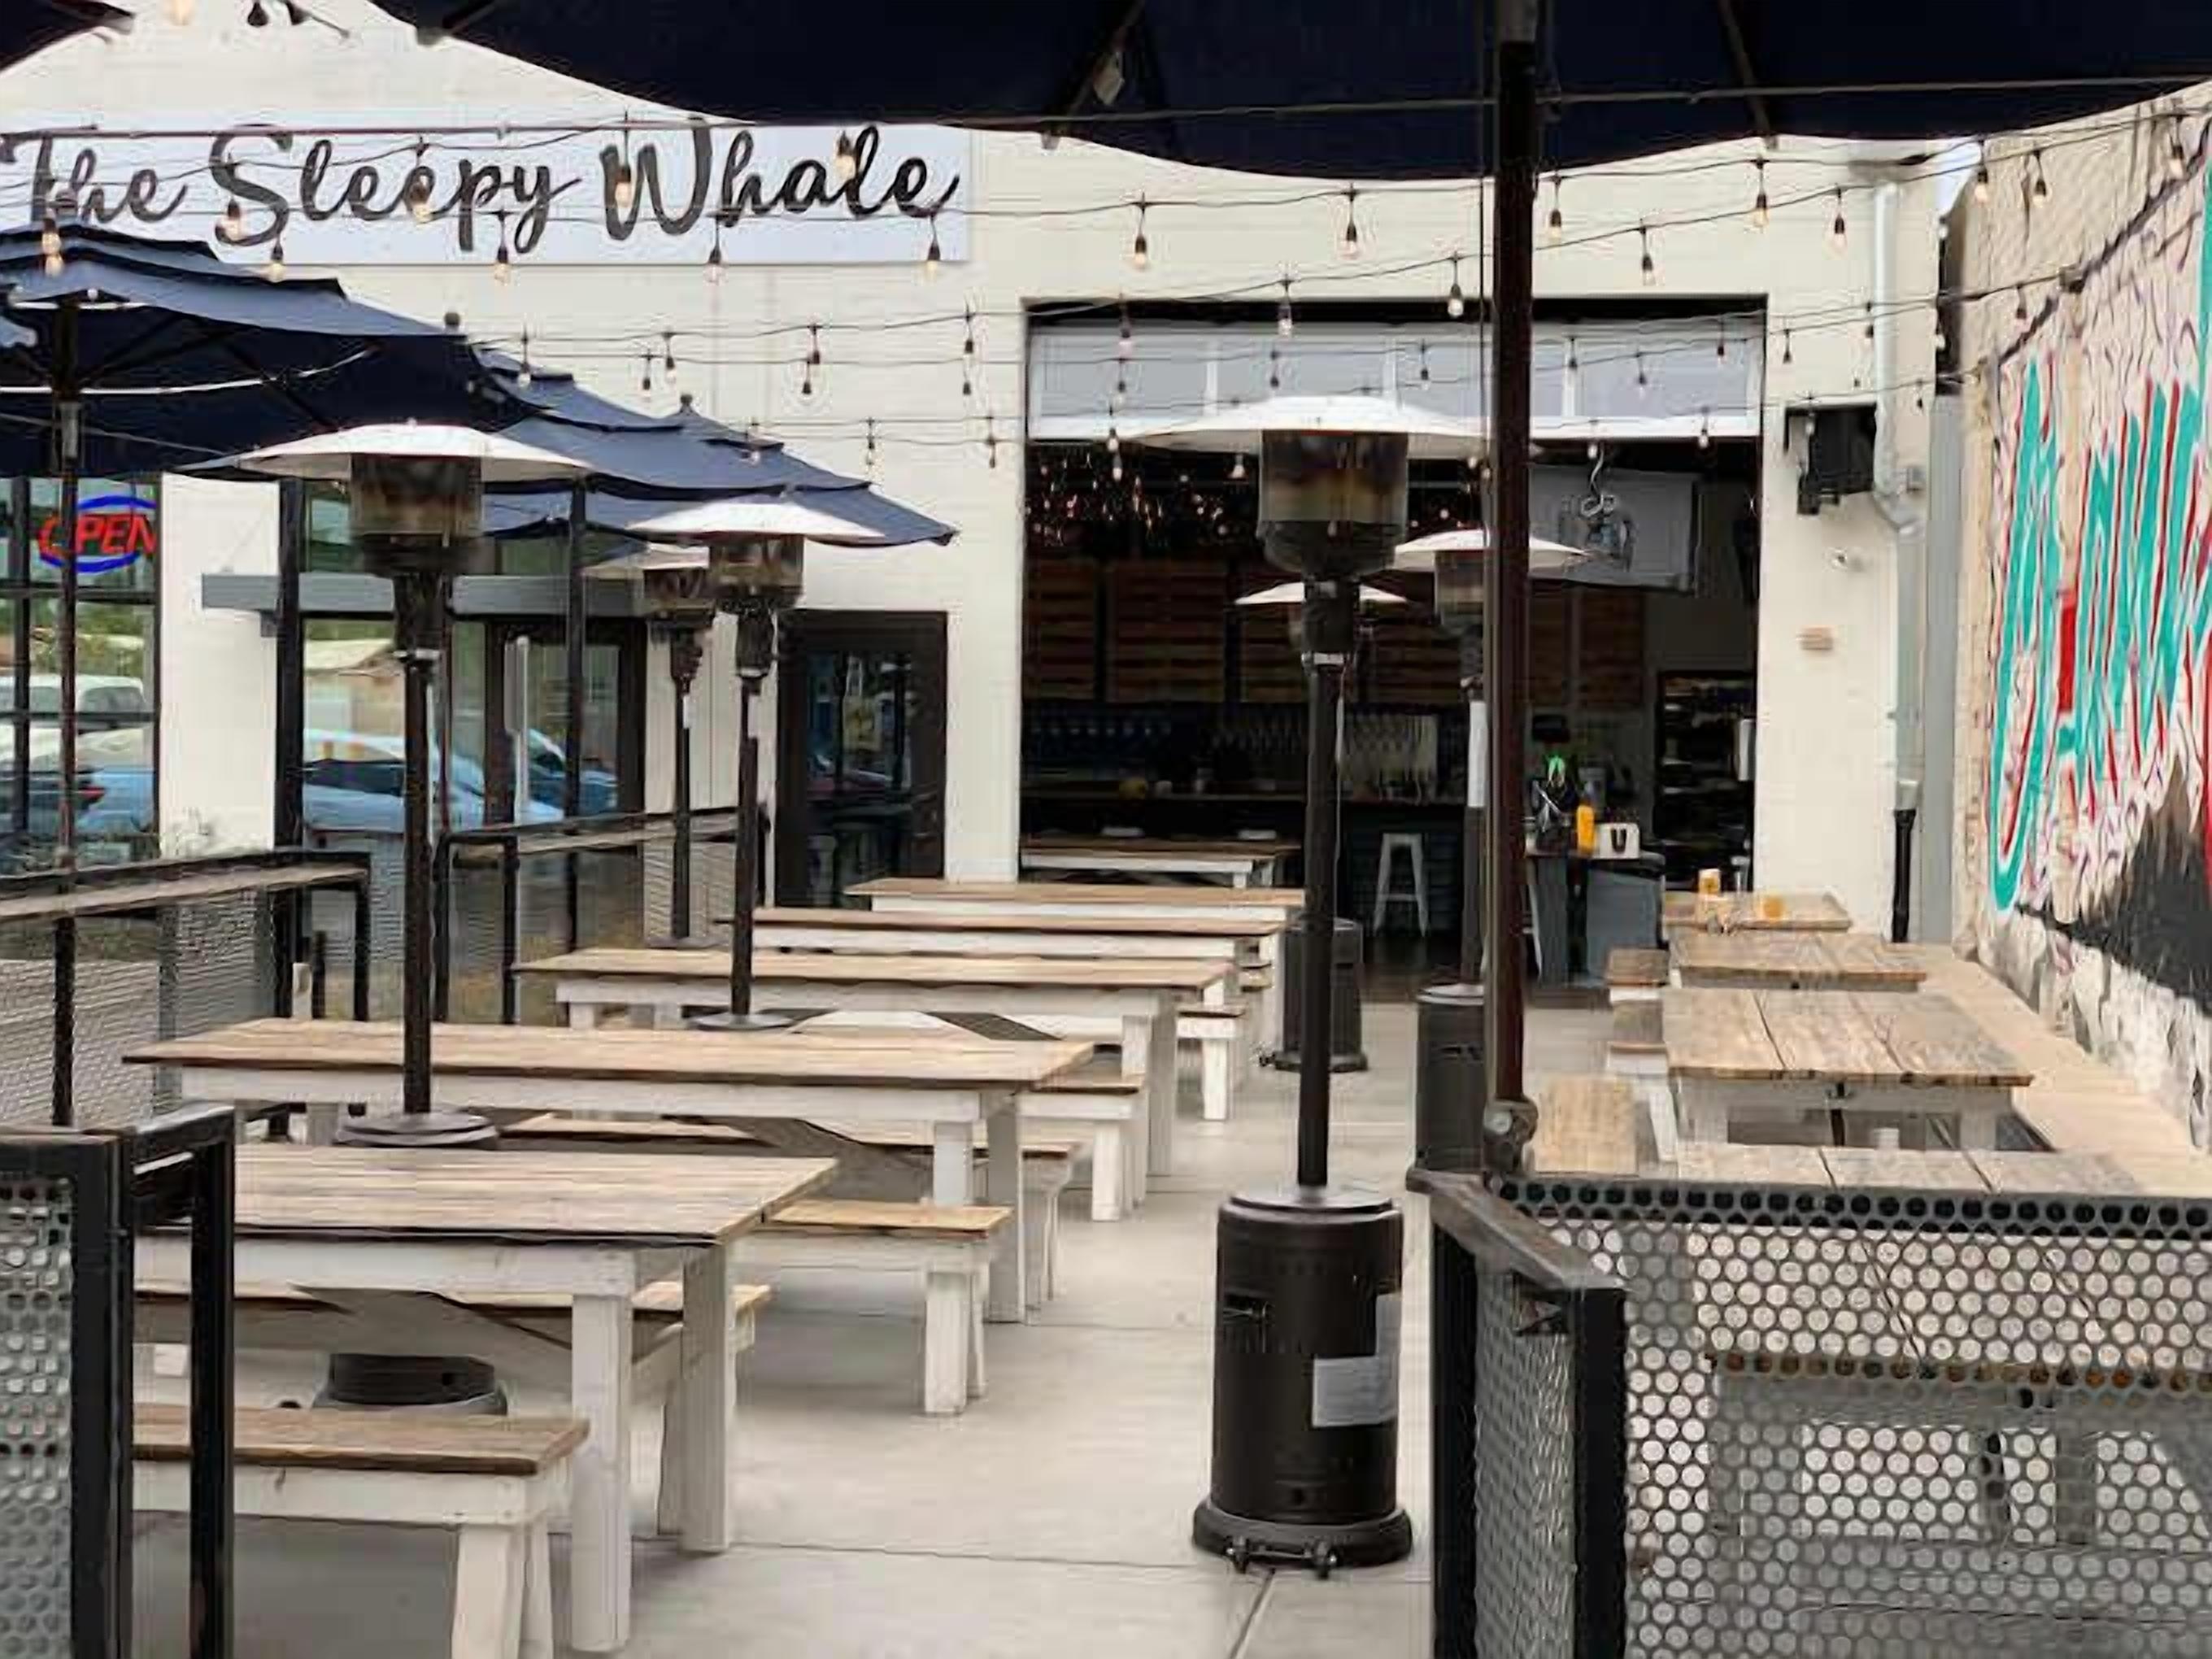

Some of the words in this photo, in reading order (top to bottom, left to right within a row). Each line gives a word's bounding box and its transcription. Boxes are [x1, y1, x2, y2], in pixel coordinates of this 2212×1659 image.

[0, 124, 188, 224] The
[209, 123, 582, 254] Sleepy
[599, 116, 960, 241] Whale
